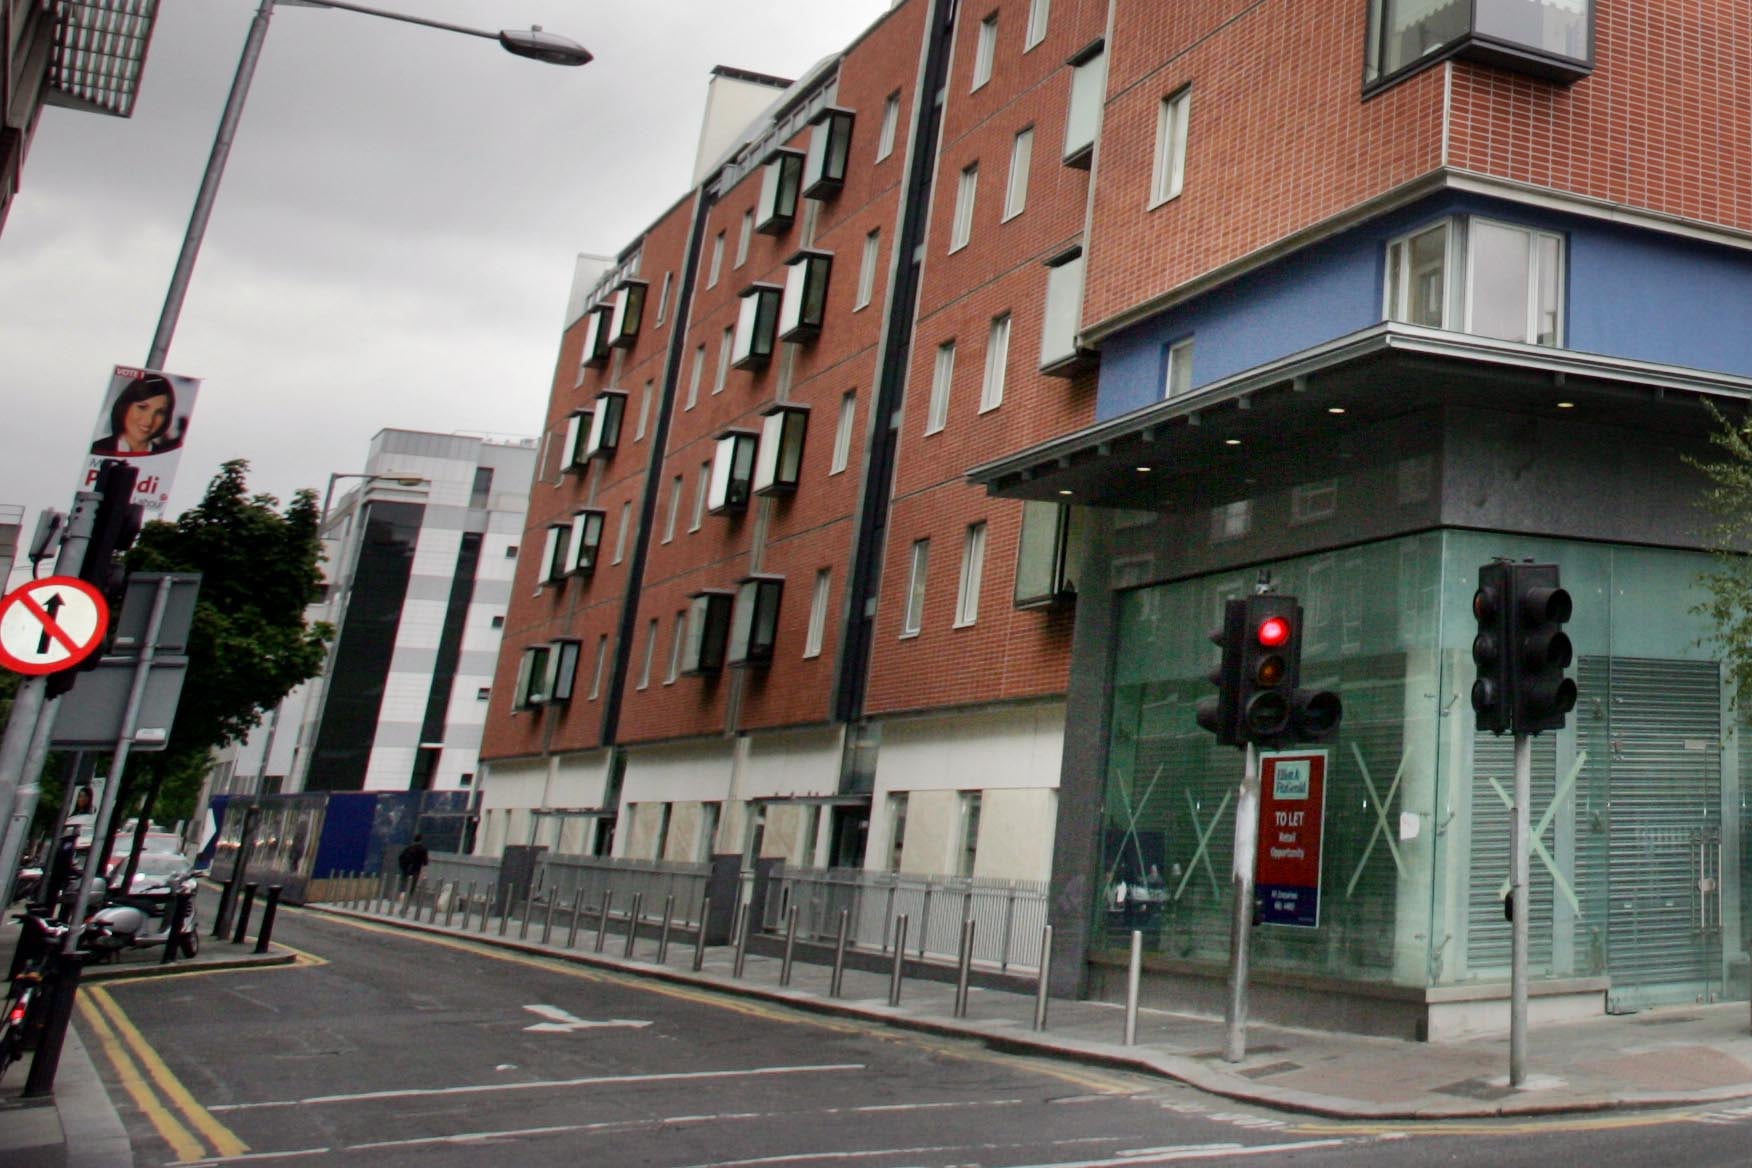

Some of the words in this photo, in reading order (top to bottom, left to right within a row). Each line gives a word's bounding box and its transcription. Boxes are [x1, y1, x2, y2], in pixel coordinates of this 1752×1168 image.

[117, 367, 138, 378] VOTE
[1275, 811, 1287, 826] TO
[1288, 811, 1304, 826] LET
